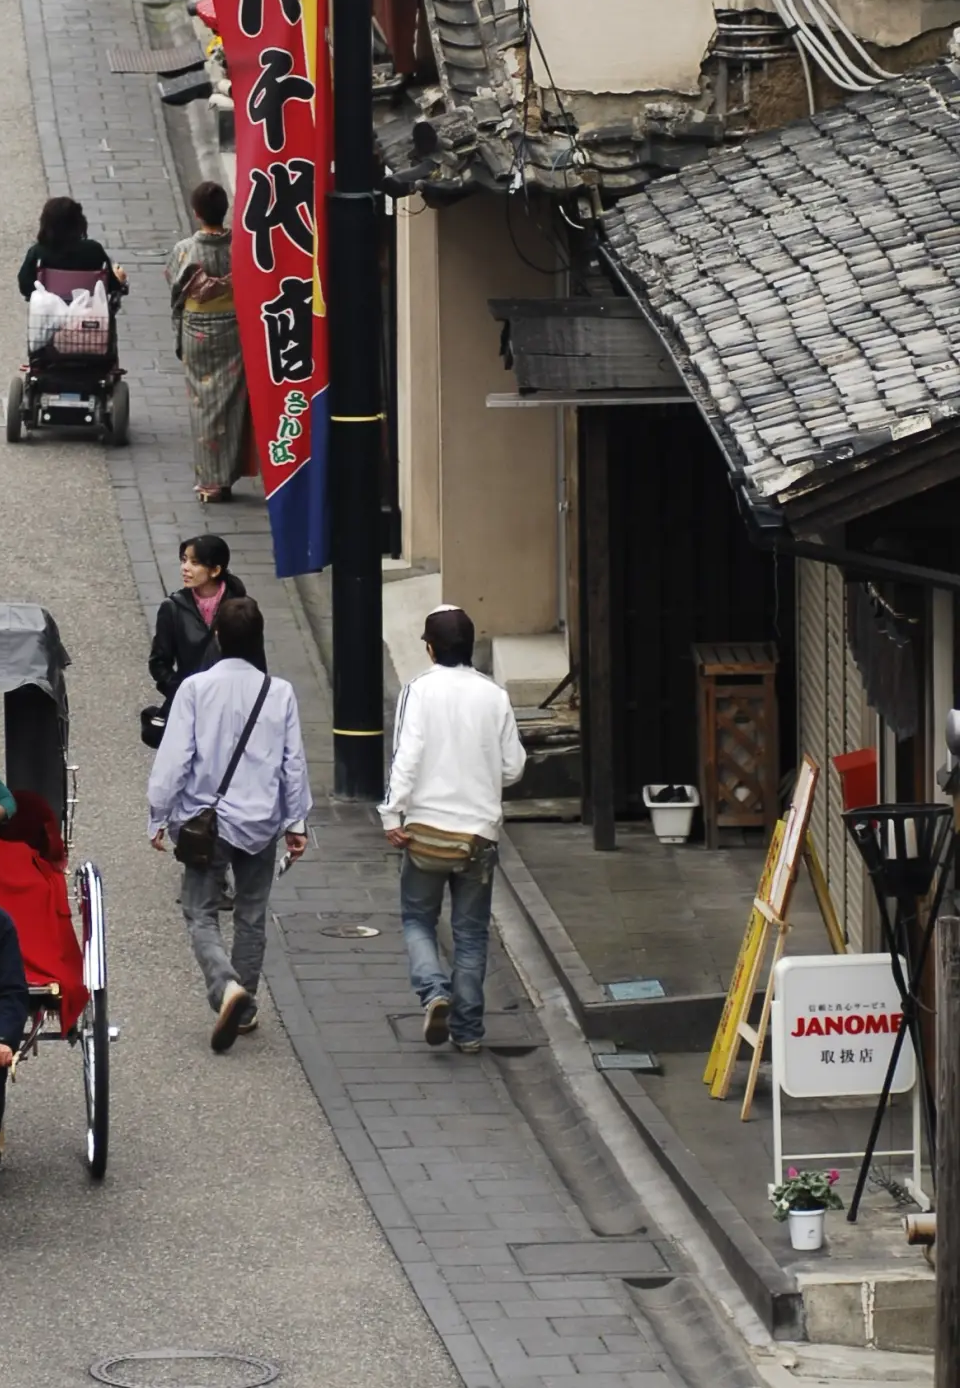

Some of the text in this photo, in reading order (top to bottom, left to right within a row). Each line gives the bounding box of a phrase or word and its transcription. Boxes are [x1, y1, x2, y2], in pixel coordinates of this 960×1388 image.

[791, 1014, 904, 1037] JANOME
[821, 1049, 873, 1064] 取扱店
